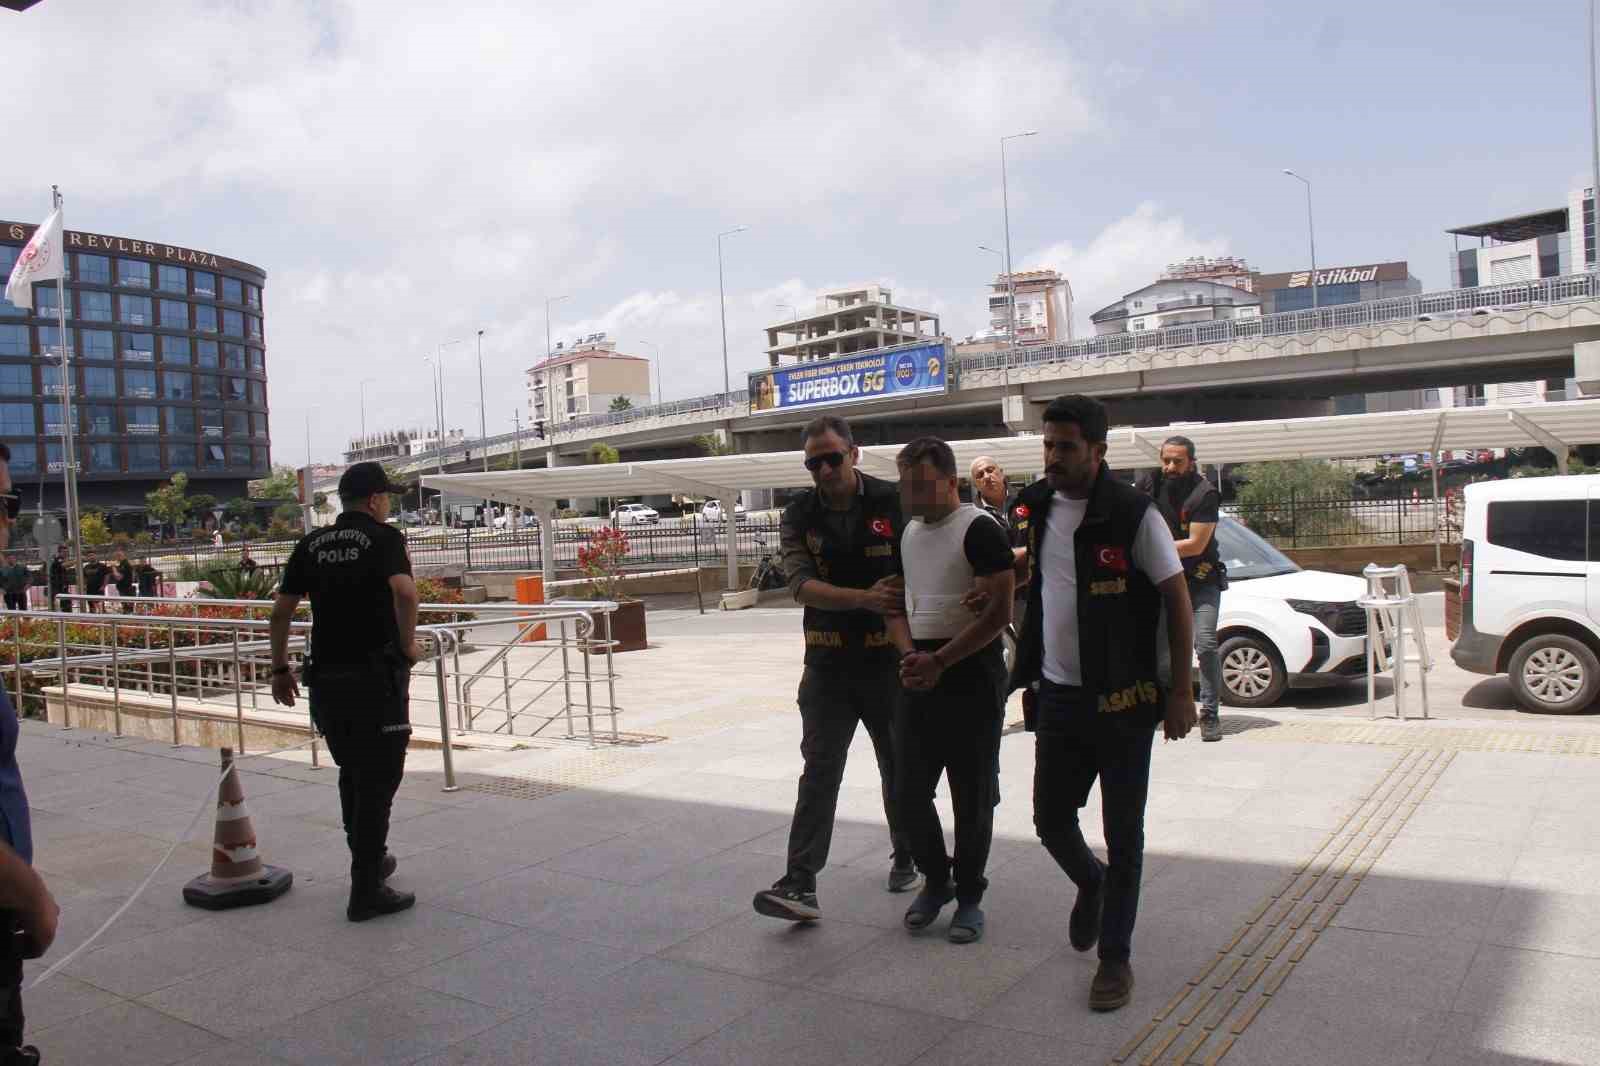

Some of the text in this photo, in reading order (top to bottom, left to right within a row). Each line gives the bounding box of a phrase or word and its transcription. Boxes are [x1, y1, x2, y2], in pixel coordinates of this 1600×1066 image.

[70, 232, 218, 267] REVLER PLAZA
[788, 374, 861, 402] SUPERBOX
[863, 370, 885, 393] 5G
